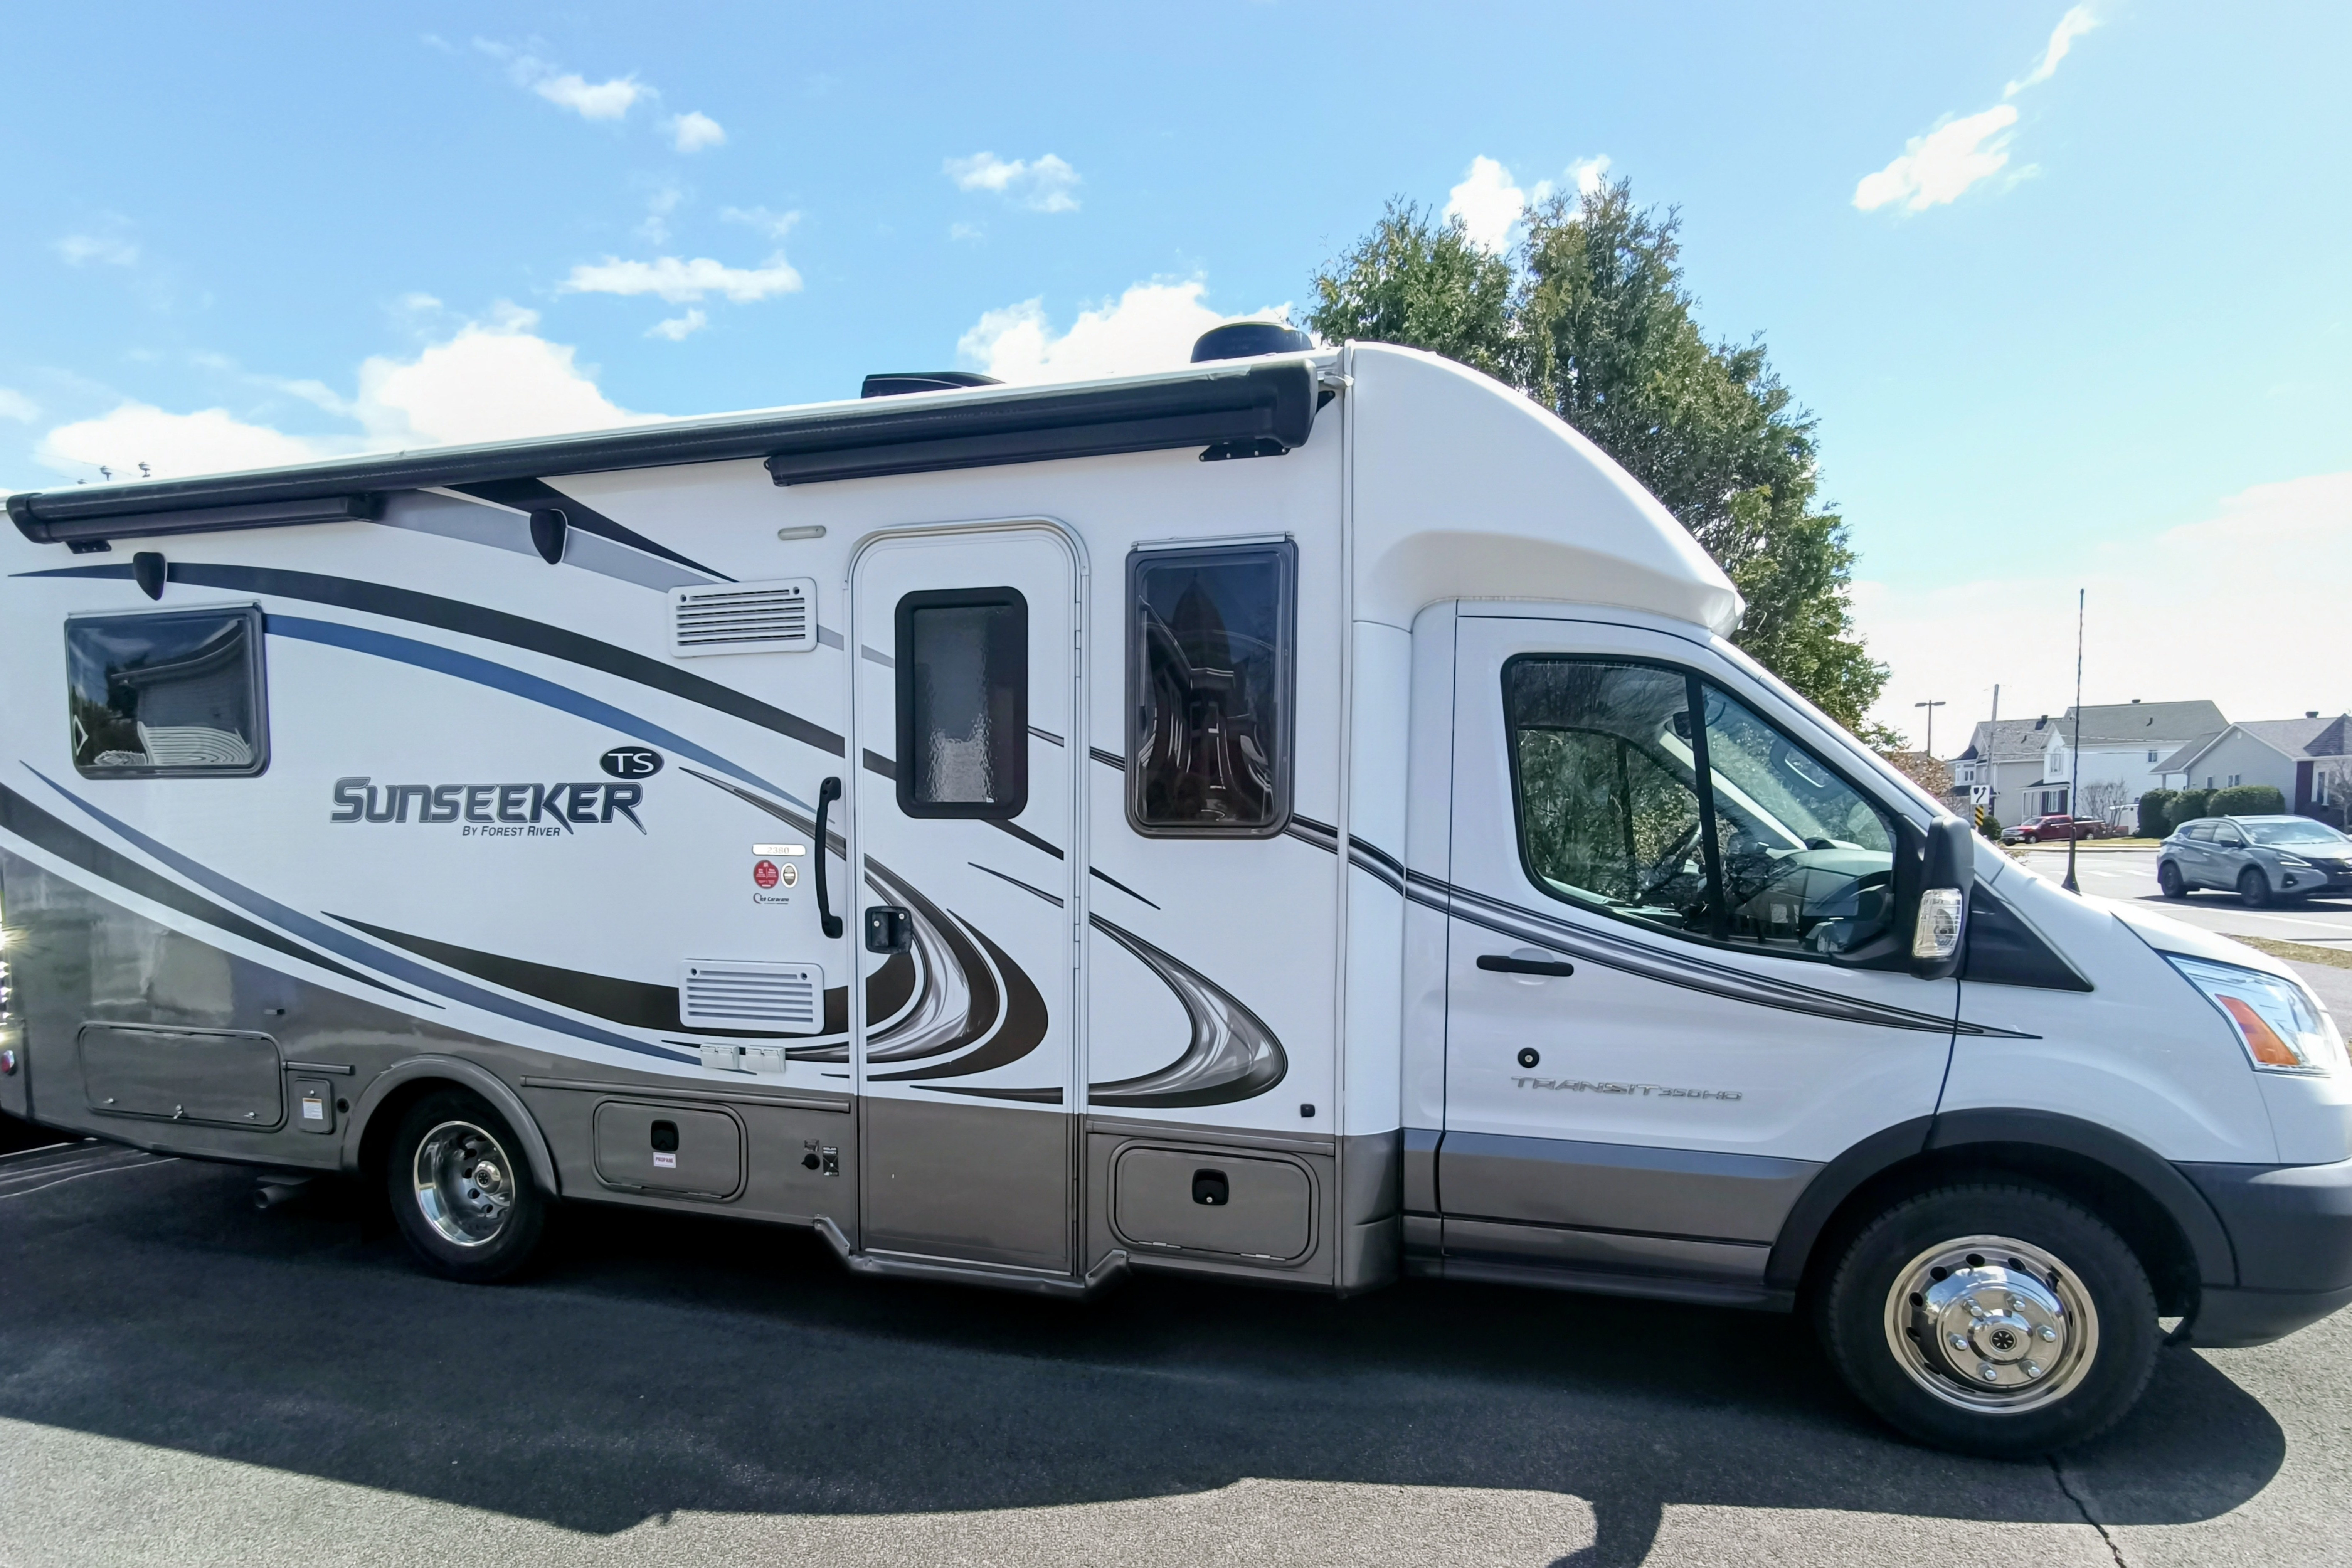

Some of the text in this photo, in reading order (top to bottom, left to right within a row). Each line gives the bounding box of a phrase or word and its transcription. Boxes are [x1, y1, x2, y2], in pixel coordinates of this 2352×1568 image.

[607, 752, 654, 773] TS
[330, 776, 647, 835] SUNSEEKER
[481, 826, 524, 836] FOREST
[527, 826, 560, 836] RIVER
